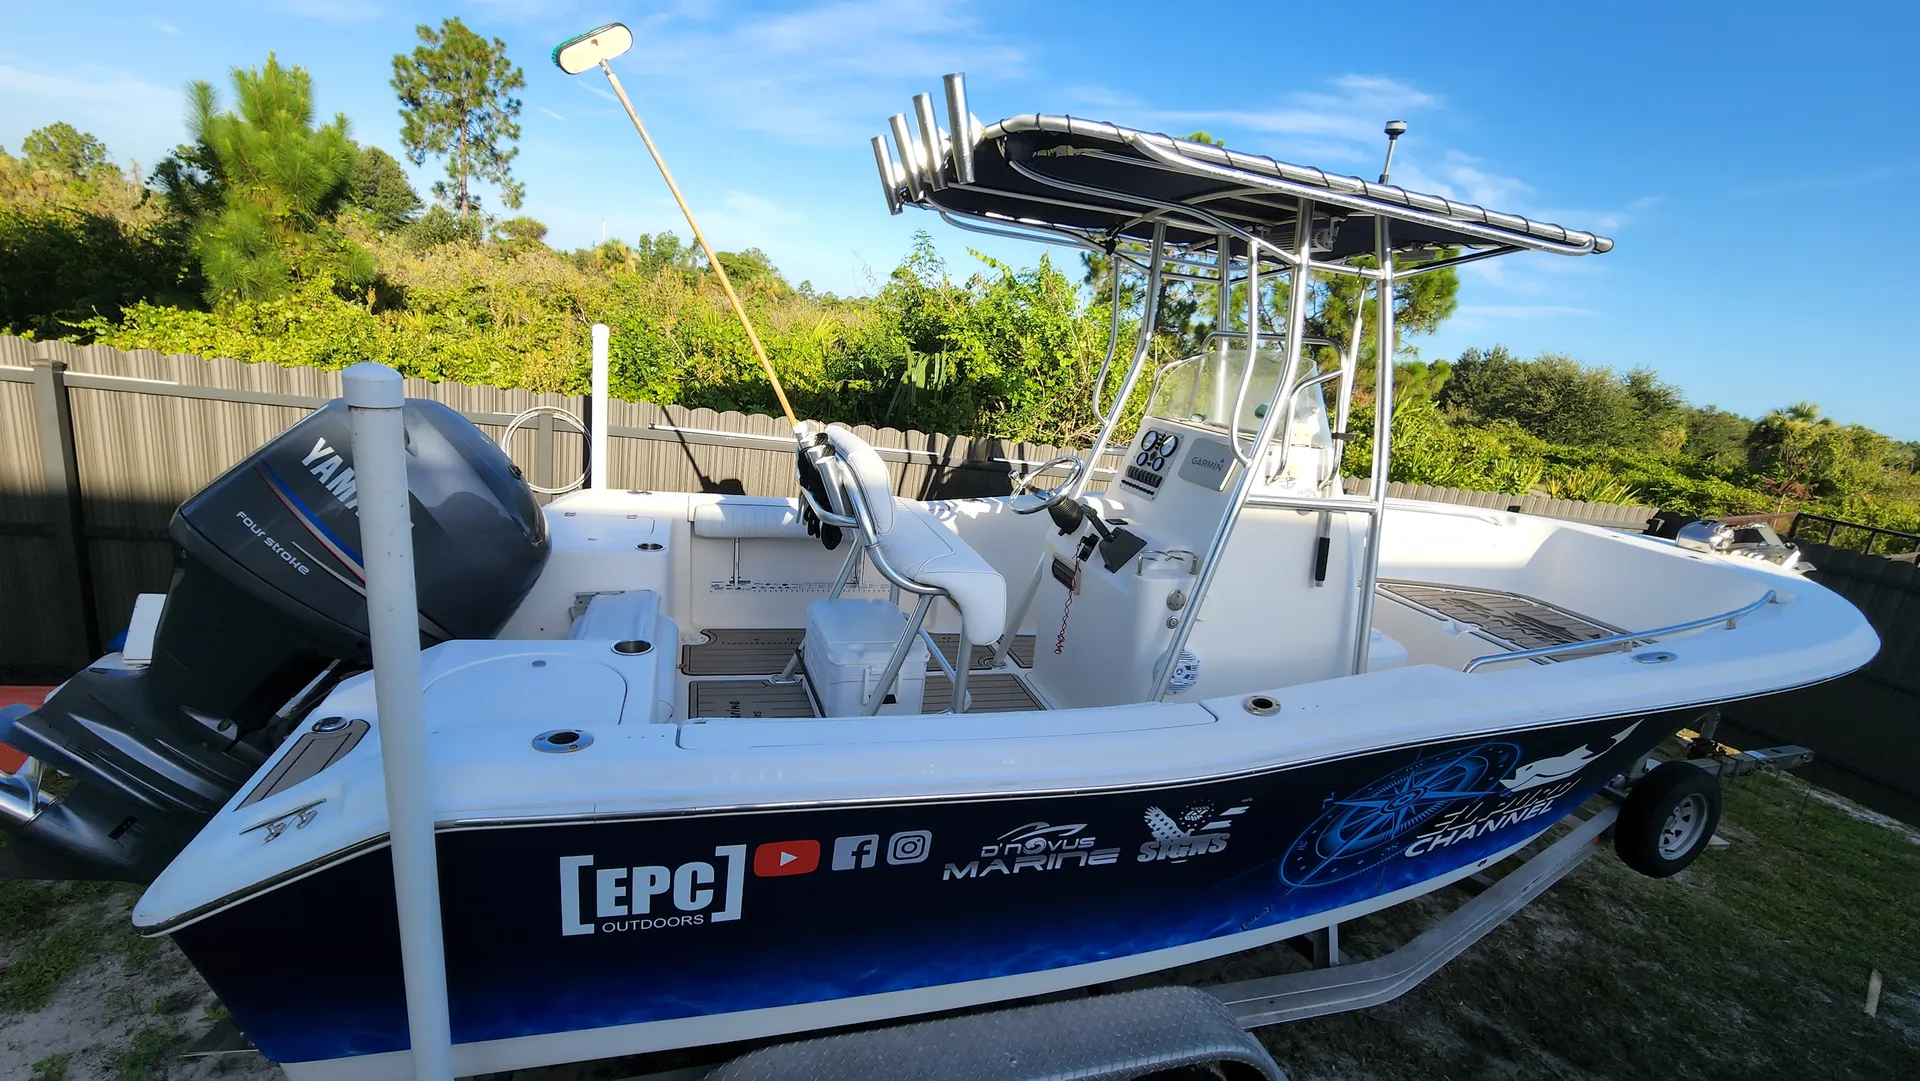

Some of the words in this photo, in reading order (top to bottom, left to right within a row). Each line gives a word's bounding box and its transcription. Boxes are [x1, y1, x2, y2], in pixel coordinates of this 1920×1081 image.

[1191, 456, 1224, 472] GARMIN
[1404, 800, 1555, 858] CHANNEL
[943, 848, 1121, 881] MARINE
[602, 914, 704, 934] OUTDOORS
